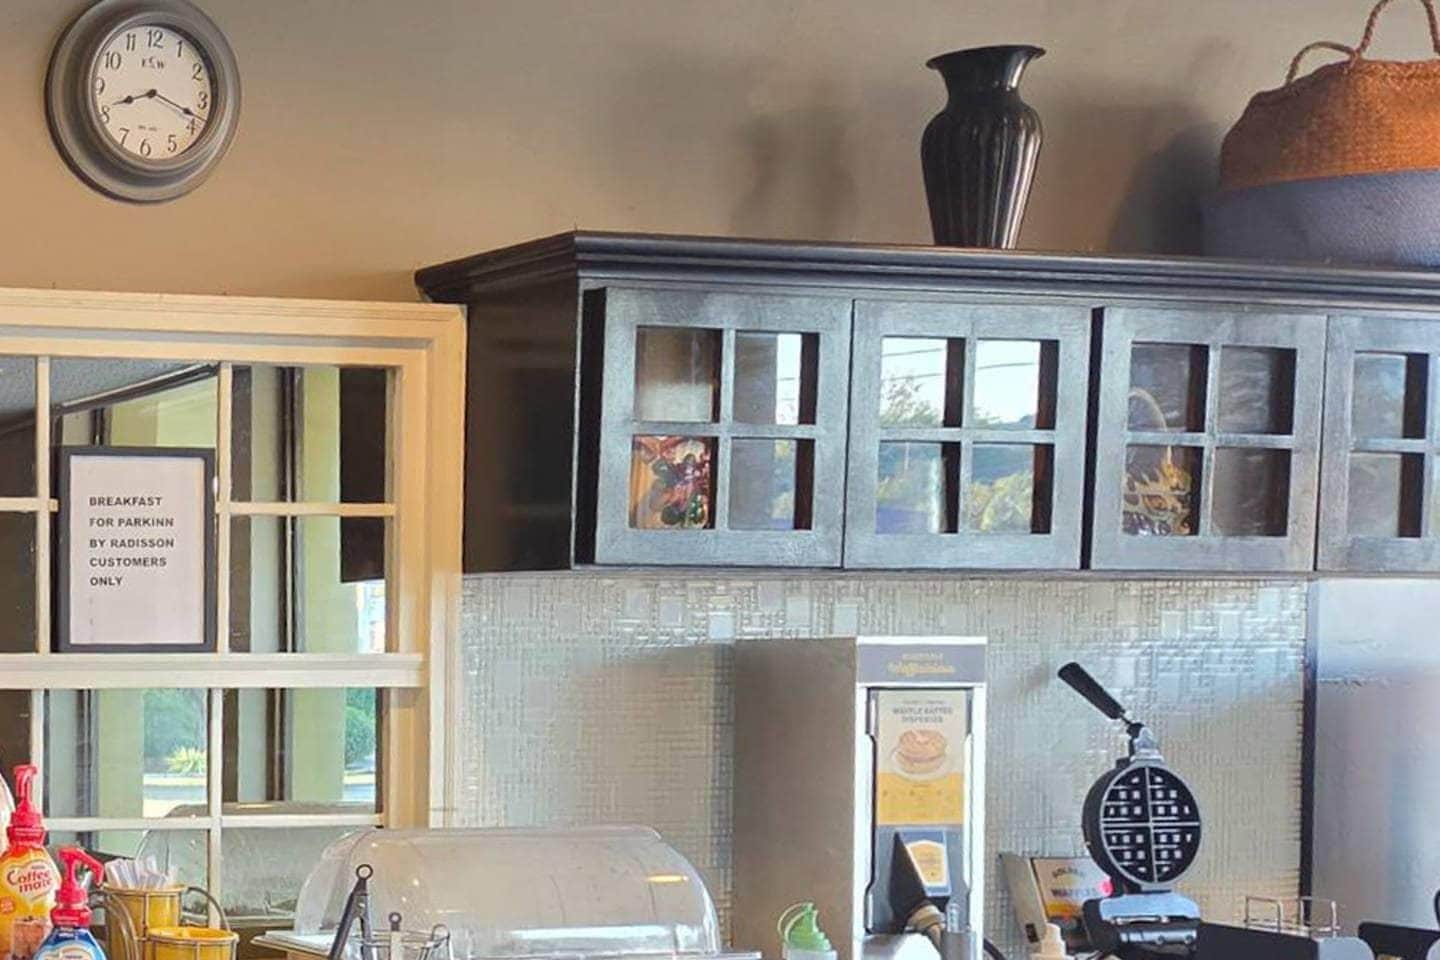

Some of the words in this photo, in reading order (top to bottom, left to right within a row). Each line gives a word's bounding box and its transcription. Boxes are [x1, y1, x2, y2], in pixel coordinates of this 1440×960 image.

[125, 33, 136, 51] 11
[147, 29, 164, 49] 12
[104, 51, 121, 70] 10
[192, 63, 202, 81] 2
[96, 77, 106, 95] 9
[197, 91, 208, 110] 3
[101, 105, 110, 124] 8
[119, 127, 130, 145] 7
[186, 118, 196, 136] 4
[139, 138, 152, 157] 6
[167, 135, 177, 153] 5
[89, 496, 163, 507] BREAKFAST
[89, 517, 114, 528] FOR
[89, 538, 106, 549] BY
[110, 538, 175, 549] RADISSON
[89, 557, 168, 568] CUSTOMERS
[89, 577, 123, 587] ONLY
[7, 870, 50, 886] Coffee
[19, 879, 52, 893] mate
